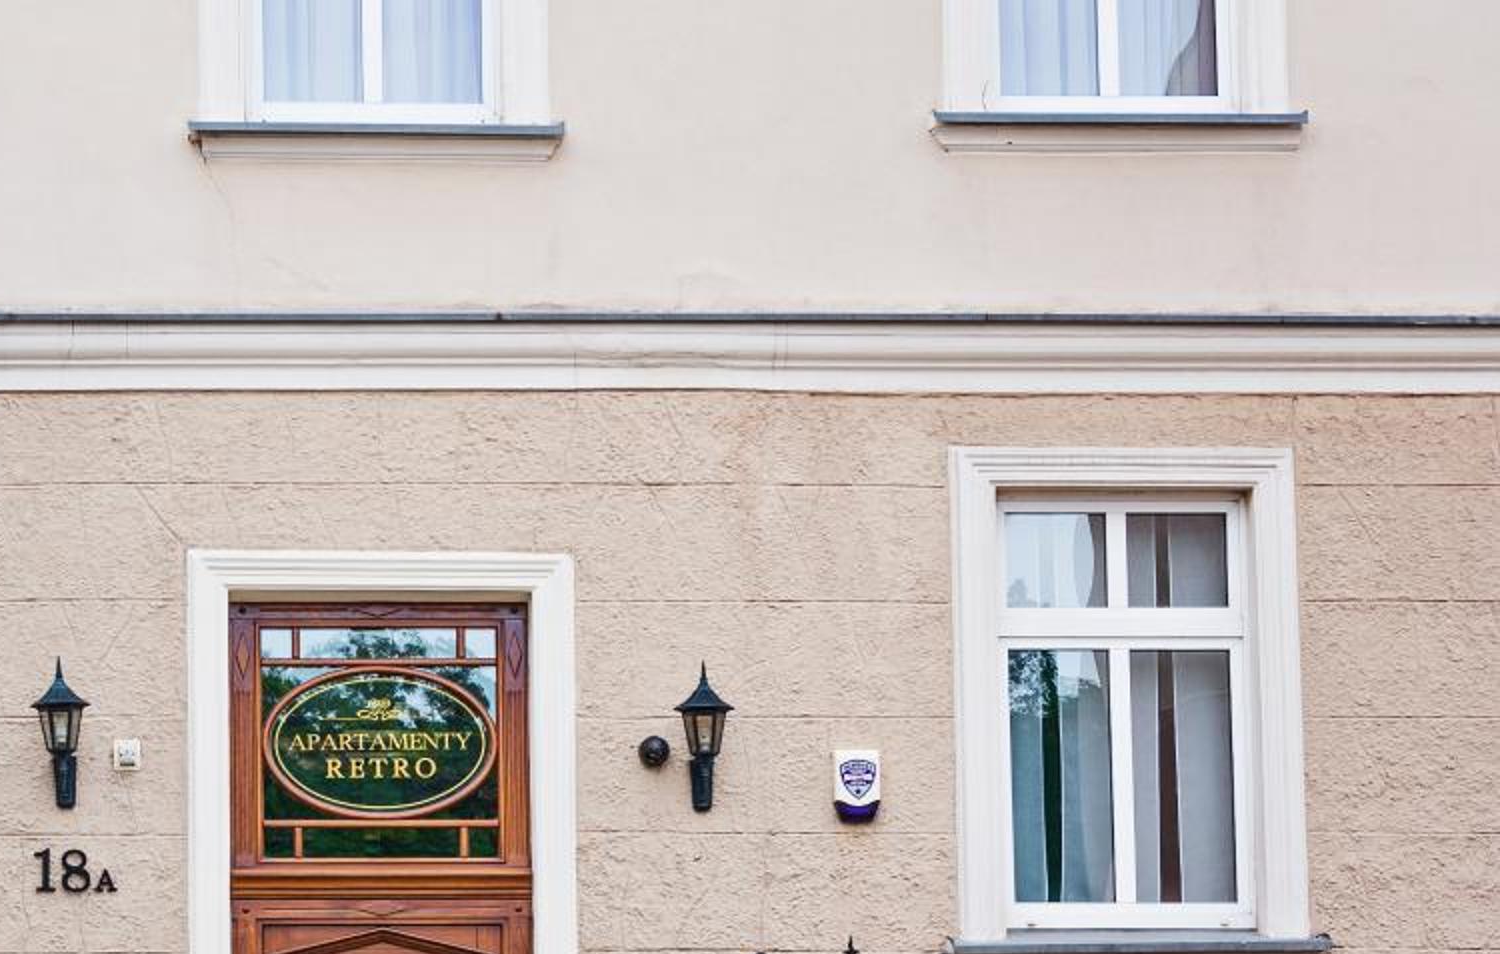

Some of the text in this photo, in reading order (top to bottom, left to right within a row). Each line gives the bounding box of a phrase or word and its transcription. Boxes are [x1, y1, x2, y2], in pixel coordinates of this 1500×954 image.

[289, 731, 472, 751] APARTAMENTY
[325, 757, 437, 779] RETRO
[33, 848, 118, 893] 18A
